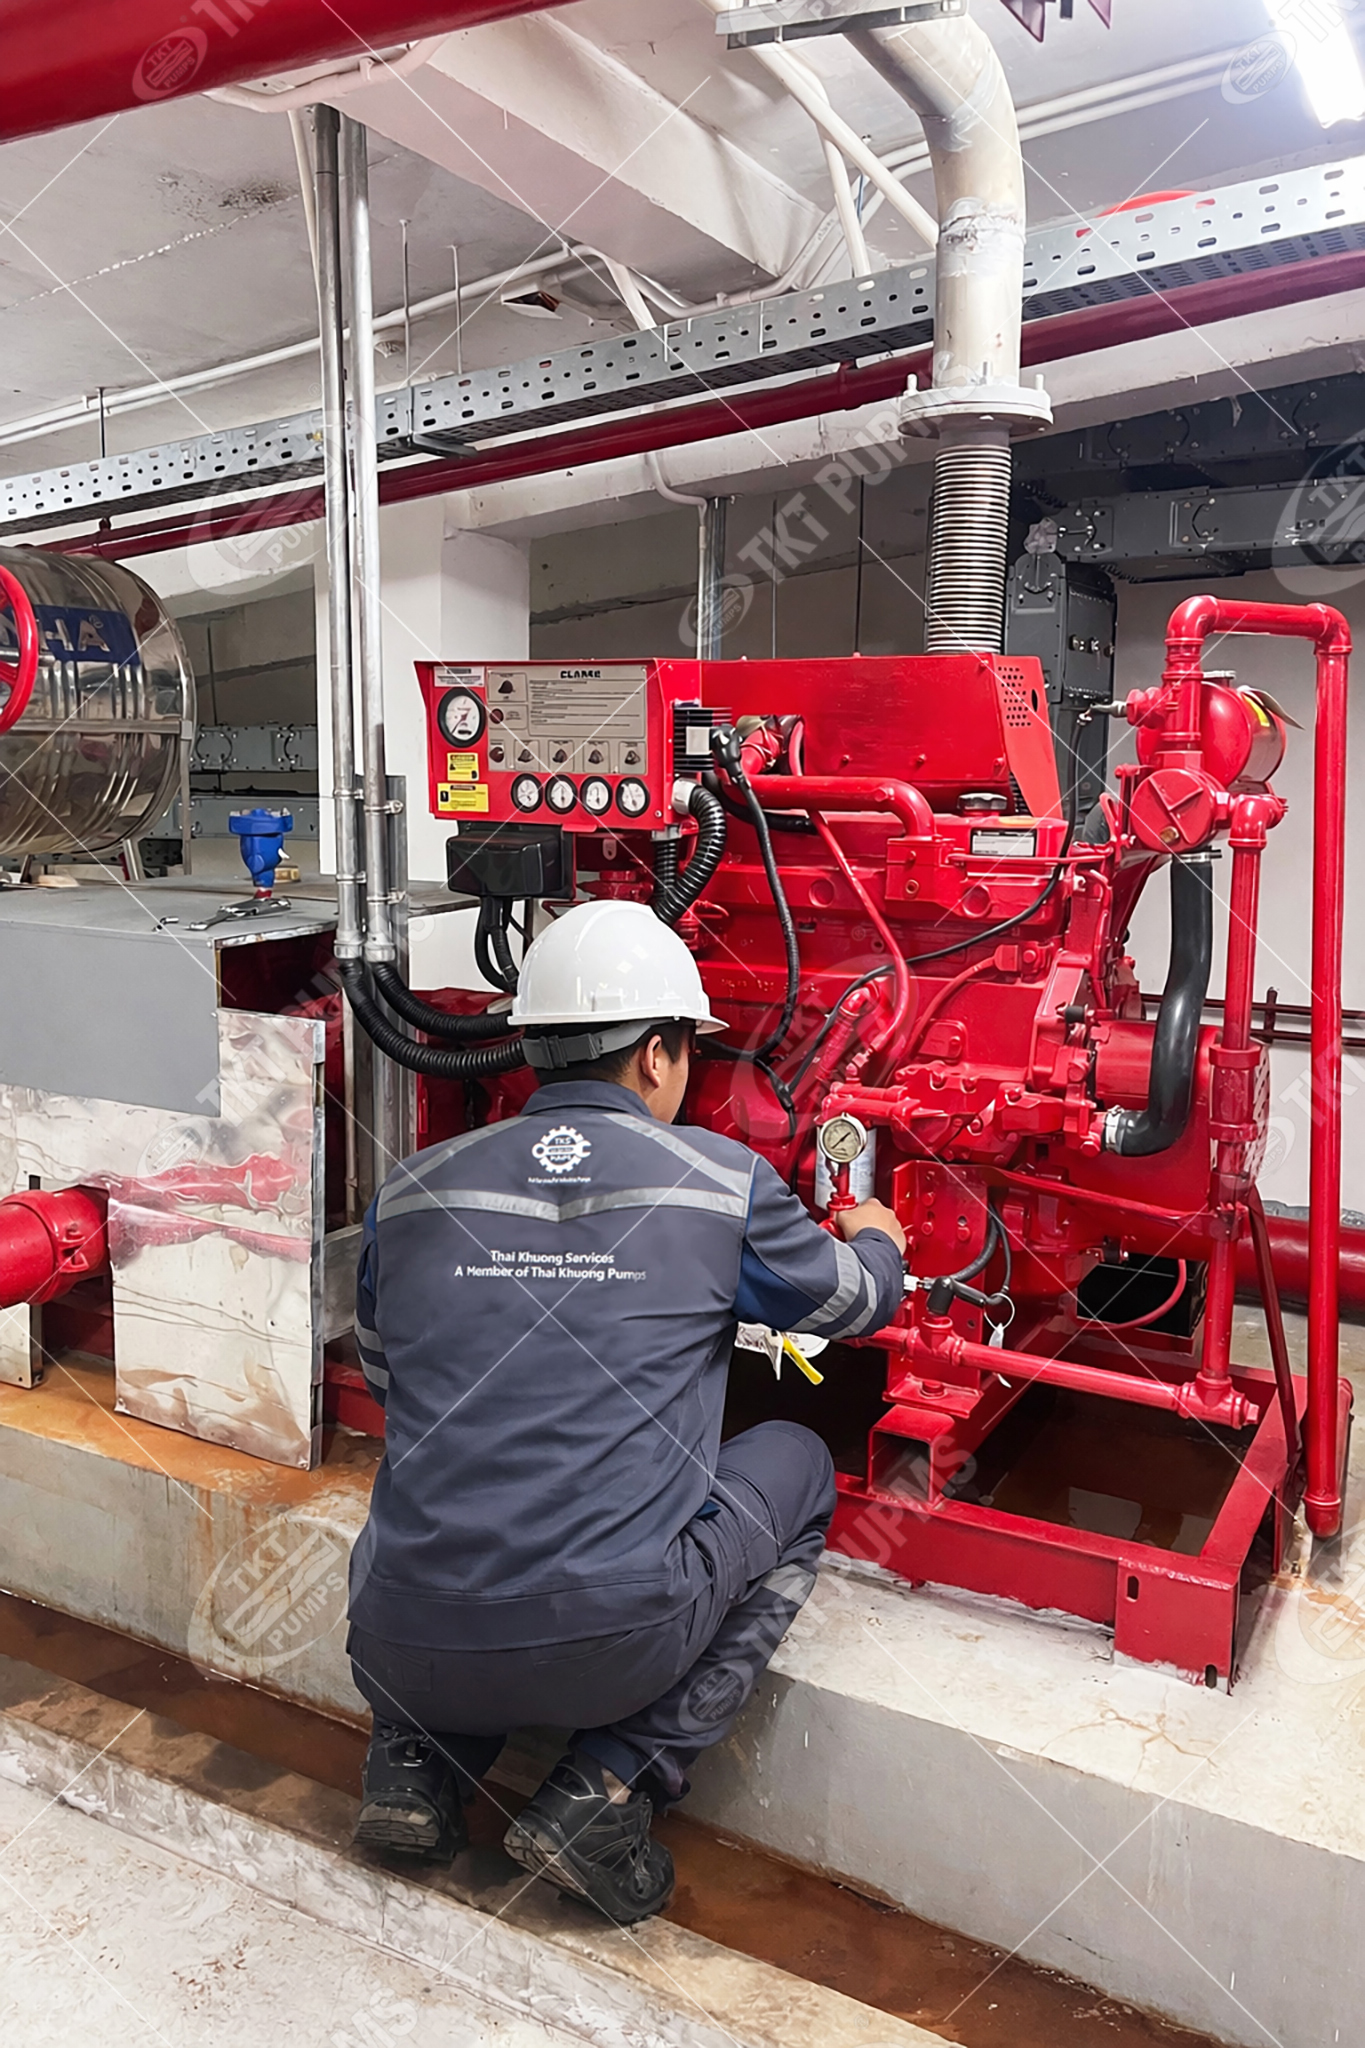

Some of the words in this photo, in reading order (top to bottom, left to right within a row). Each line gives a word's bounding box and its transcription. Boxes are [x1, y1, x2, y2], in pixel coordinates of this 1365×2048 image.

[490, 1250, 515, 1263] Thai
[518, 1252, 563, 1266] Khuong
[565, 1252, 615, 1264] Services
[454, 1266, 463, 1277] A
[467, 1266, 512, 1277] Member
[515, 1266, 530, 1277] of
[531, 1267, 556, 1278] Thai
[558, 1268, 604, 1281] Khuong
[607, 1268, 647, 1282] Pumps
